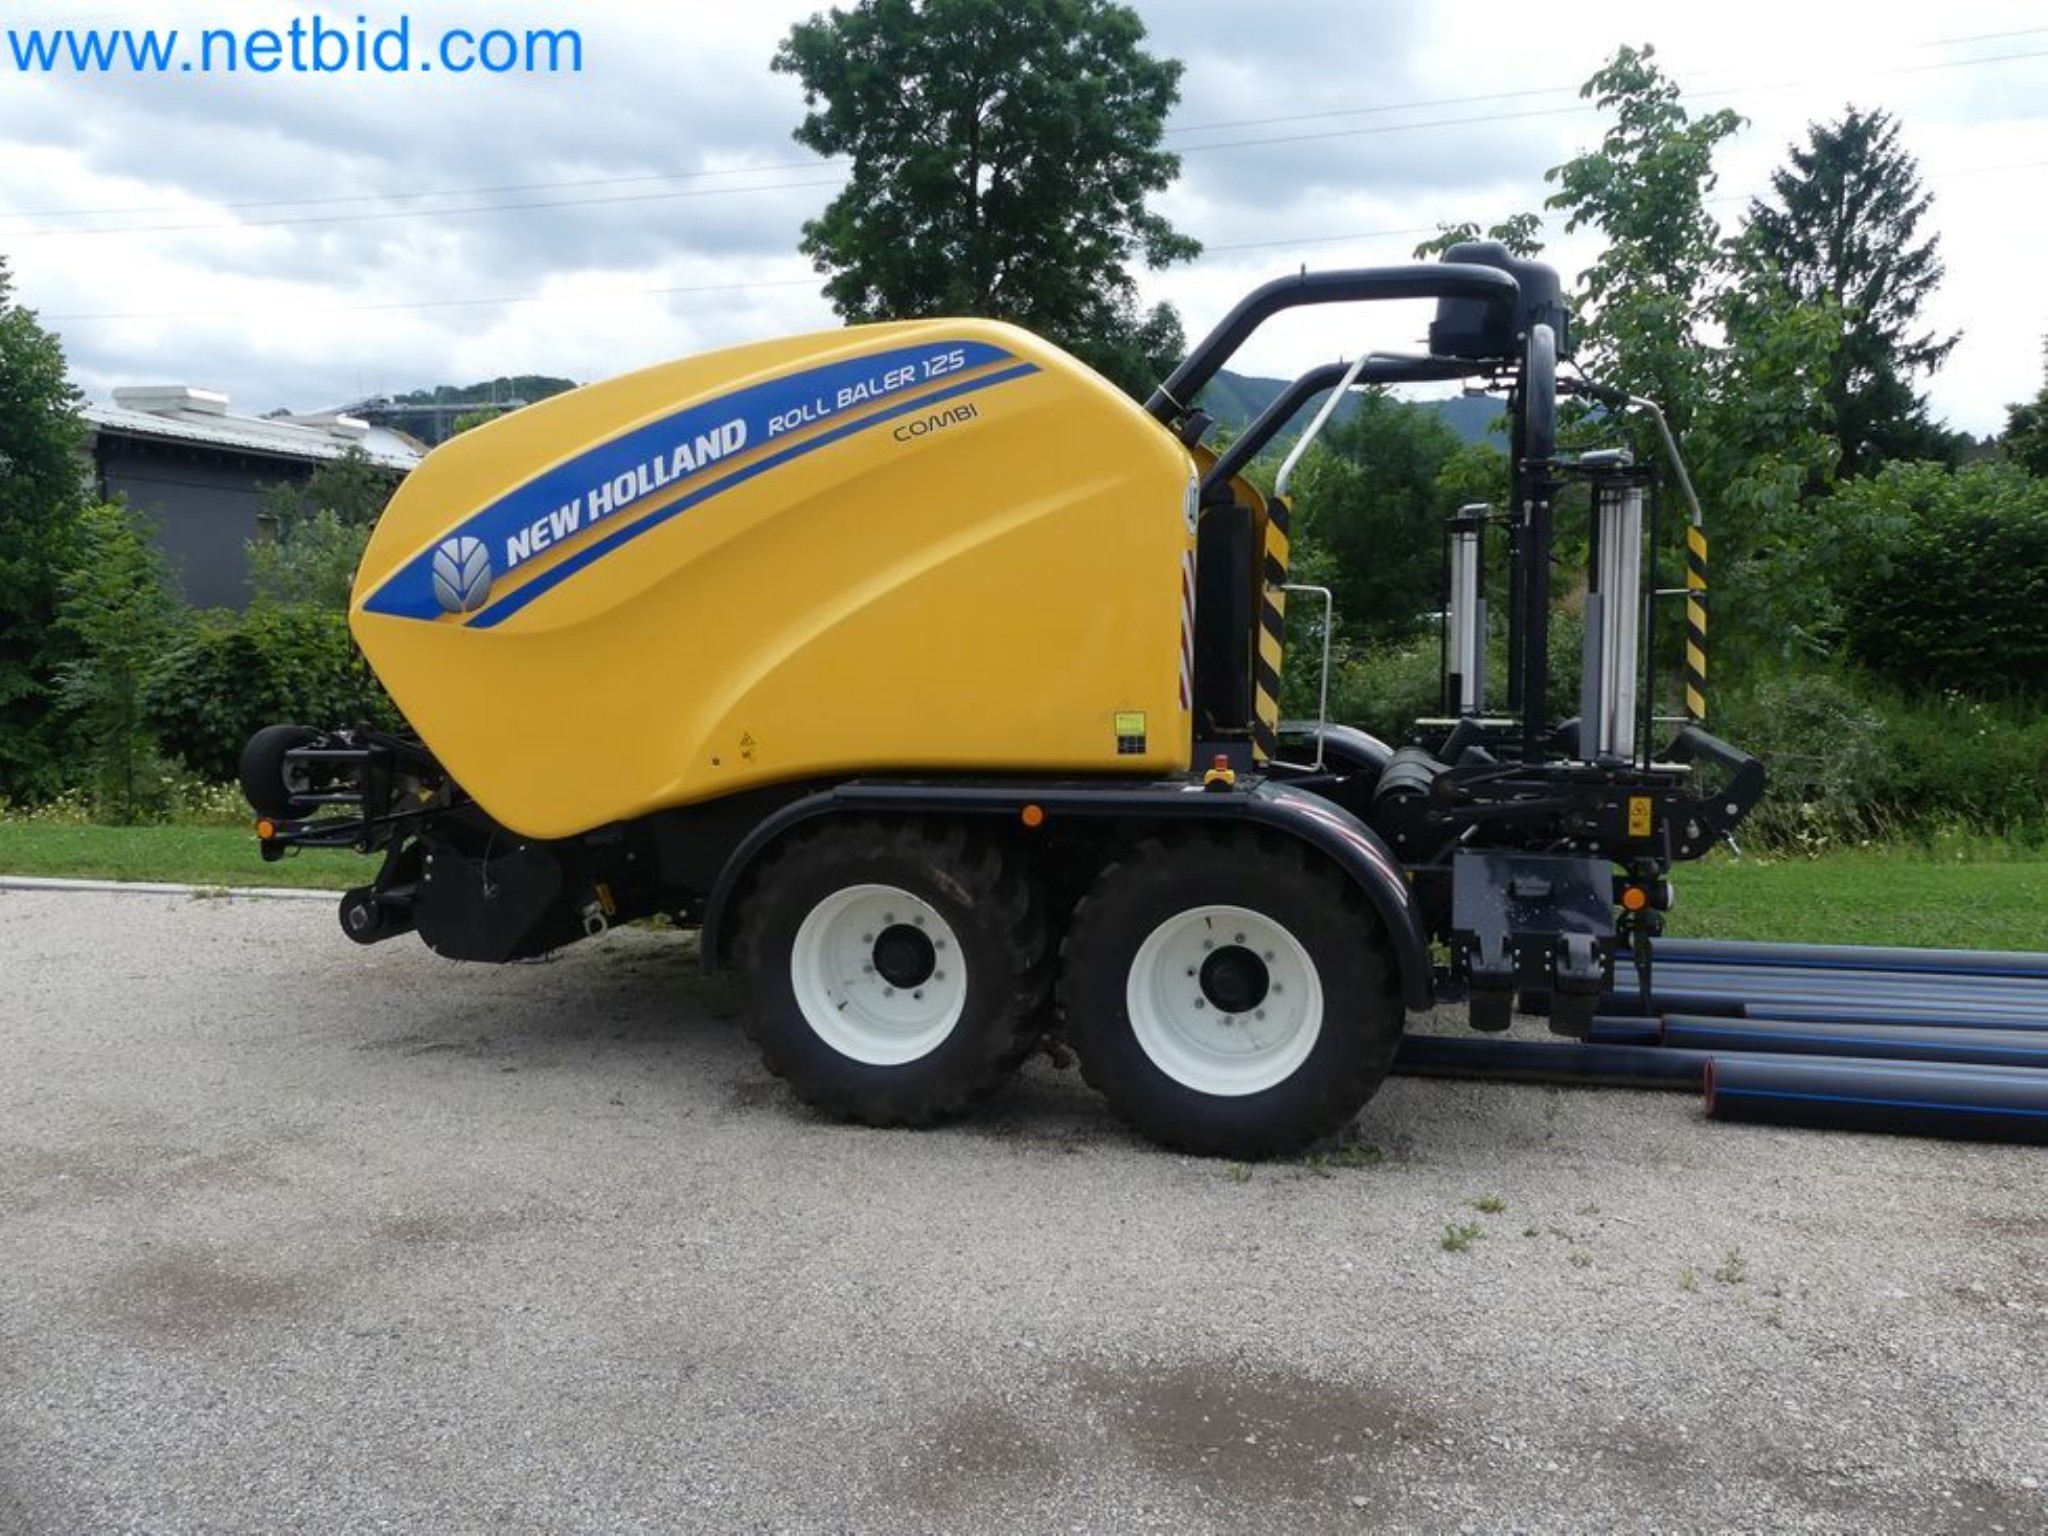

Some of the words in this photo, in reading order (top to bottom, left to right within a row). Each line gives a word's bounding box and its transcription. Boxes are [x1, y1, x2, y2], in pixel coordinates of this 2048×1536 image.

[768, 398, 831, 437] ROLL
[836, 364, 916, 409] BALER
[921, 348, 966, 378] 125
[893, 402, 979, 442] COMBI
[506, 499, 581, 567] NEW
[588, 417, 748, 521] HOLLAND
